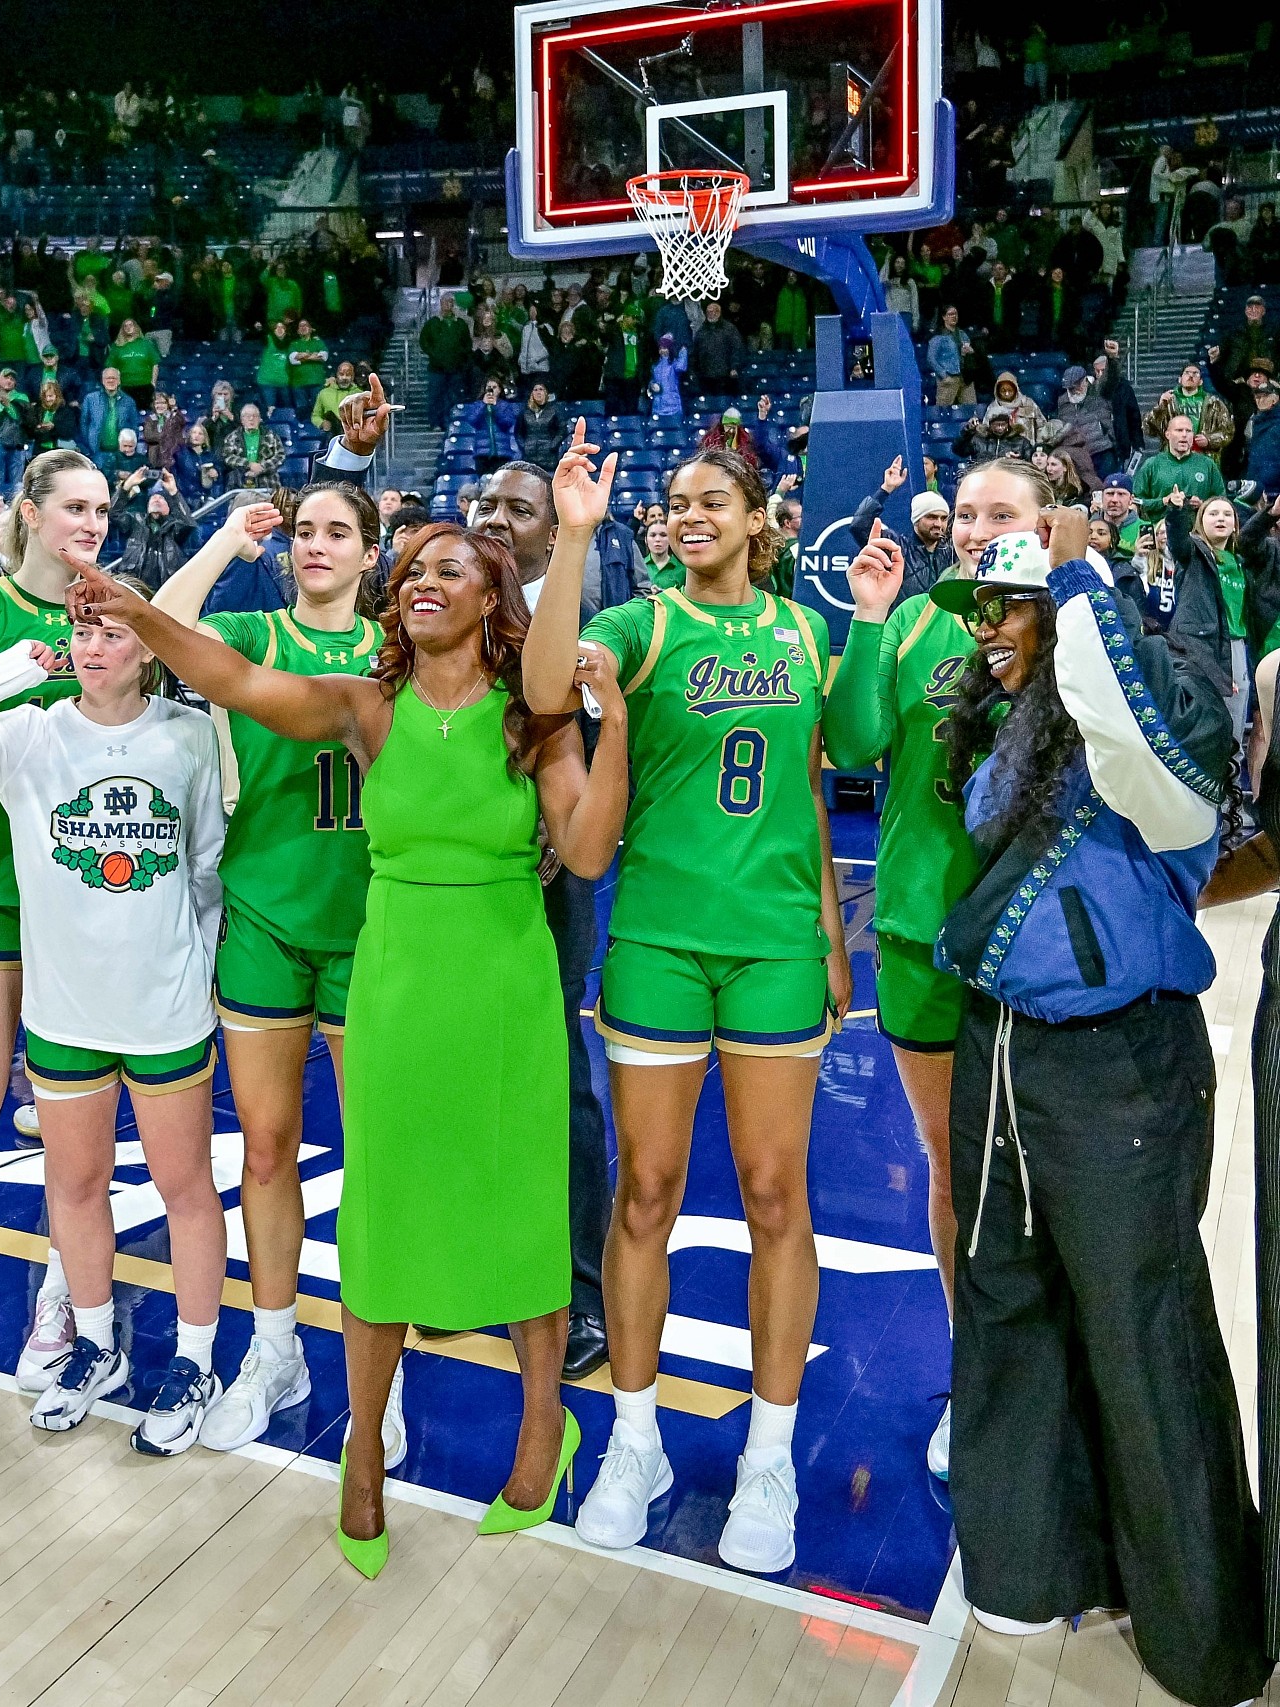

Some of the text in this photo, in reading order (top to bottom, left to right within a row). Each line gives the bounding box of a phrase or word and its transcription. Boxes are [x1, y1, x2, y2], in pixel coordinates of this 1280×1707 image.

[800, 556, 850, 572] NIS
[685, 652, 801, 706] Irish
[314, 750, 365, 830] 11
[717, 727, 769, 817] 8
[57, 819, 177, 840] SHAMROCK
[66, 836, 173, 849] CLASSIC
